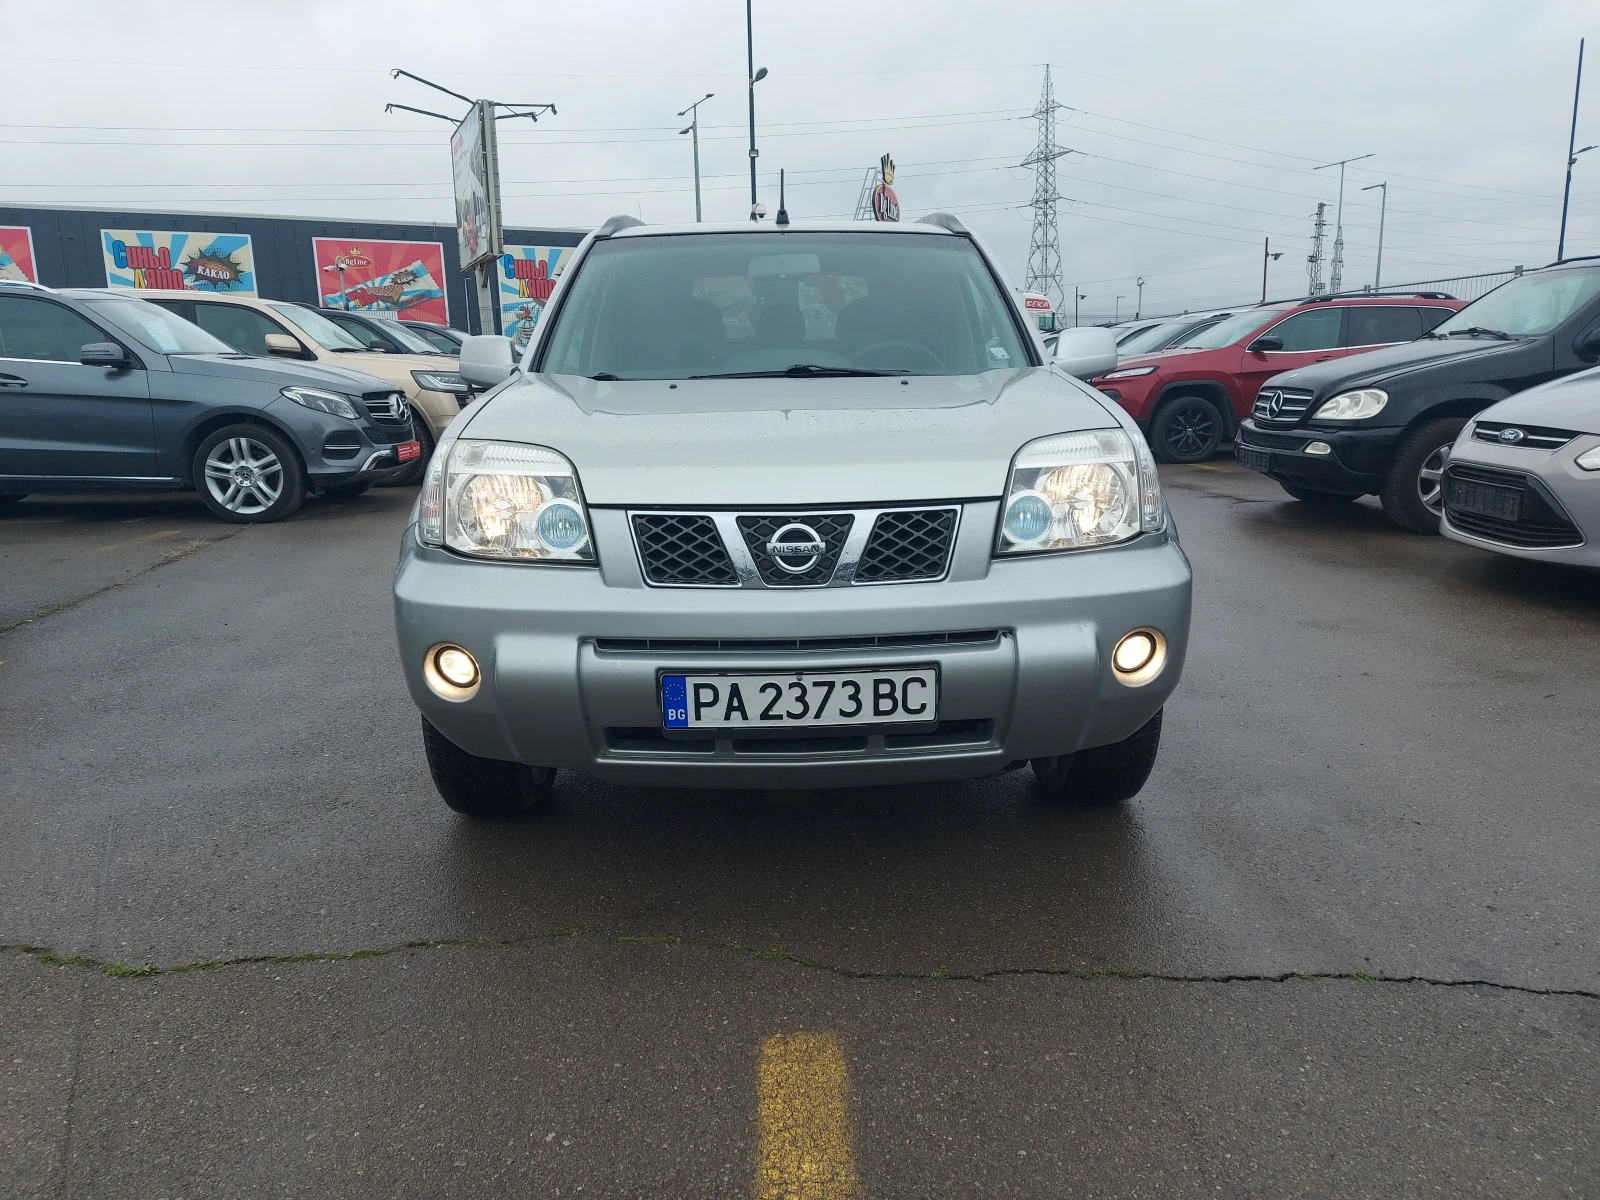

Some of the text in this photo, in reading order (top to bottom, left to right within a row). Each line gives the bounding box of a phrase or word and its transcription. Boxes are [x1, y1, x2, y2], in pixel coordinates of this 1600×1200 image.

[112, 240, 171, 269] Синьо
[197, 265, 230, 279] КАКАО
[504, 254, 547, 279] Синьо
[1501, 431, 1516, 440] Ford
[773, 544, 820, 553] NISSAN
[693, 677, 927, 721] PA 2373 BC
[668, 709, 686, 720] BG
